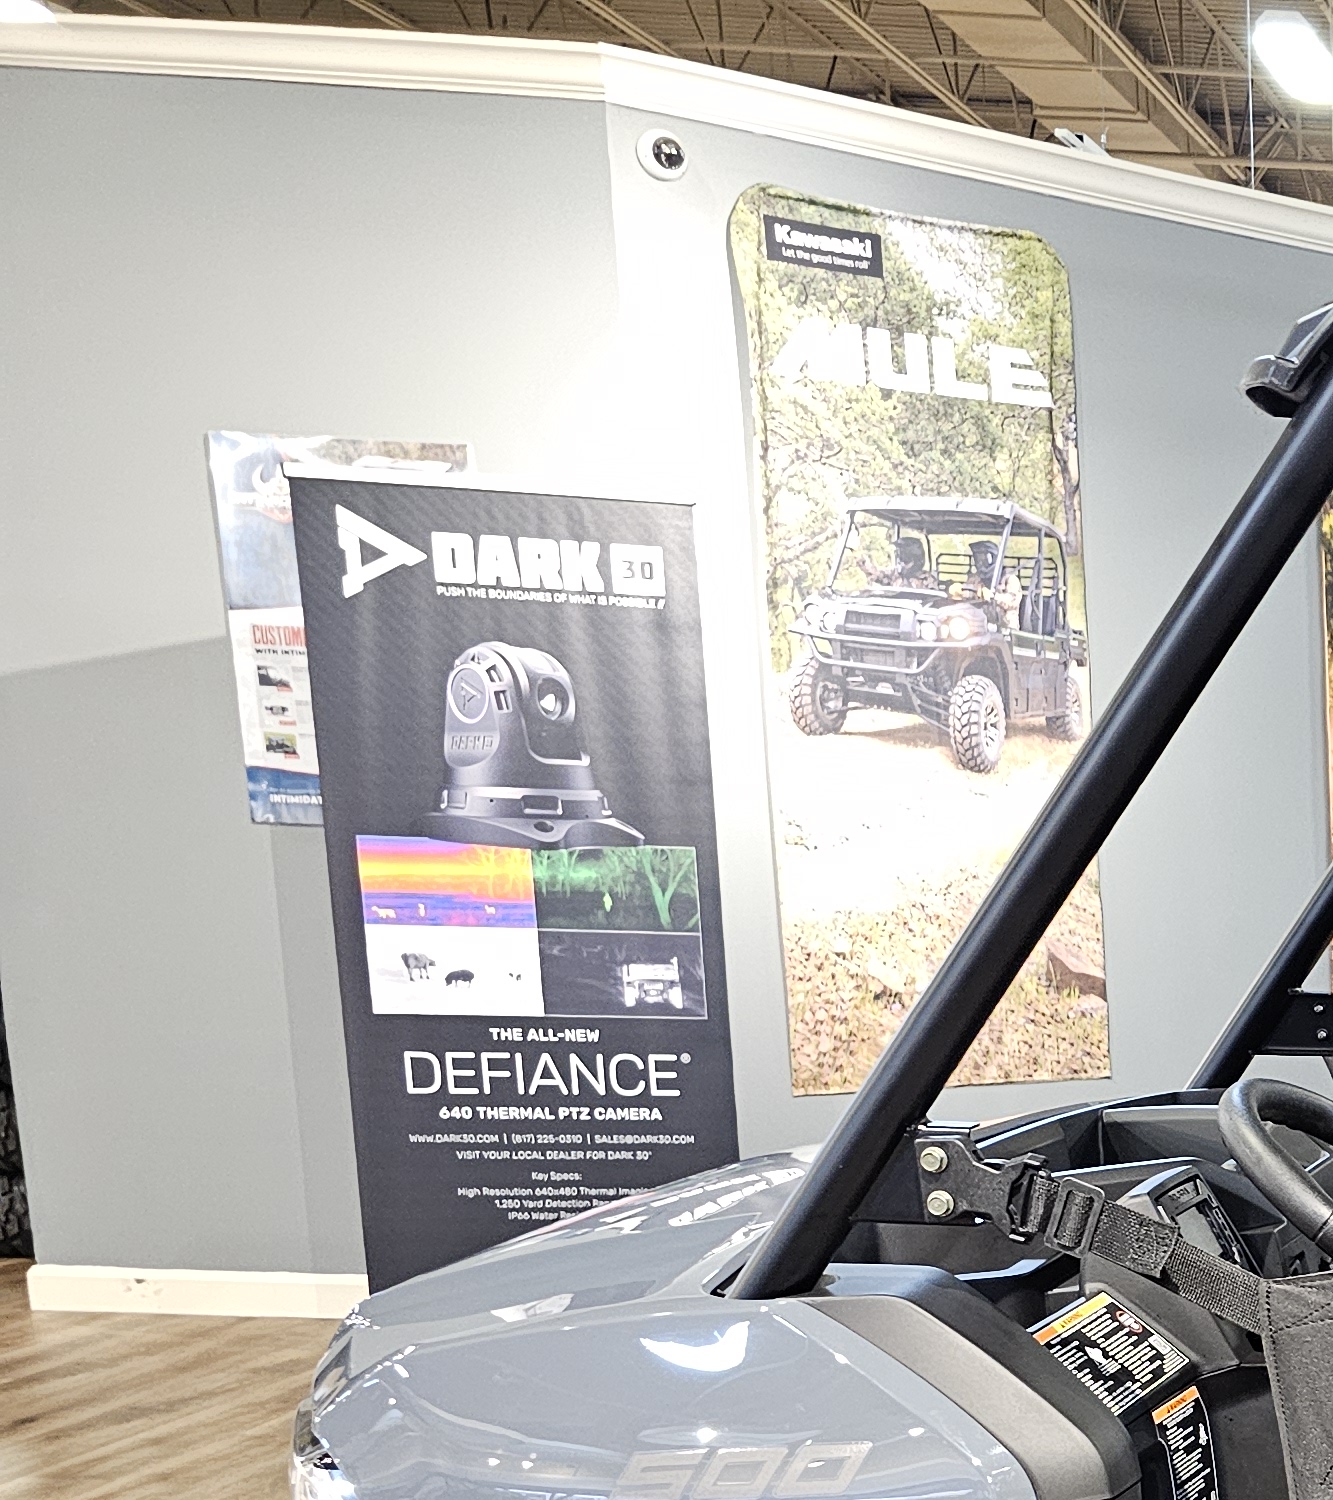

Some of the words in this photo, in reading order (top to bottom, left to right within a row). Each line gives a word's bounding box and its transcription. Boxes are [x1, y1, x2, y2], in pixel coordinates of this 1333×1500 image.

[774, 222, 873, 259] Kawasaki
[770, 320, 1055, 409] MULE
[431, 531, 605, 593] DARK
[436, 585, 465, 597] PUSH
[467, 587, 487, 599] THE
[488, 588, 552, 603] BOUNDARIES
[554, 592, 567, 604] OF
[569, 593, 596, 606] WHAT
[489, 1027, 523, 1042] THE
[527, 1028, 600, 1043] ALL-NEW
[403, 1050, 682, 1098] DEFIANCE
[439, 1105, 473, 1120] 640
[476, 1106, 555, 1121] THERMAL
[558, 1107, 591, 1121] PTZ
[593, 1107, 663, 1121] CAMERA
[456, 1150, 481, 1160] VISIT
[482, 1150, 511, 1160] YOUR
[512, 1150, 545, 1160] LOCAL
[546, 1150, 584, 1160] DEALER
[586, 1151, 606, 1160] FOR
[608, 1151, 634, 1160] DARK
[531, 1171, 549, 1182] Key
[550, 1170, 583, 1182] Specs:
[457, 1186, 481, 1199] High
[482, 1186, 534, 1197] Resolution
[535, 1187, 578, 1197] 640x480
[579, 1187, 617, 1197] Thermal
[521, 1200, 544, 1209] Yard
[545, 1199, 591, 1209] Detection
[531, 1212, 559, 1221] Water
